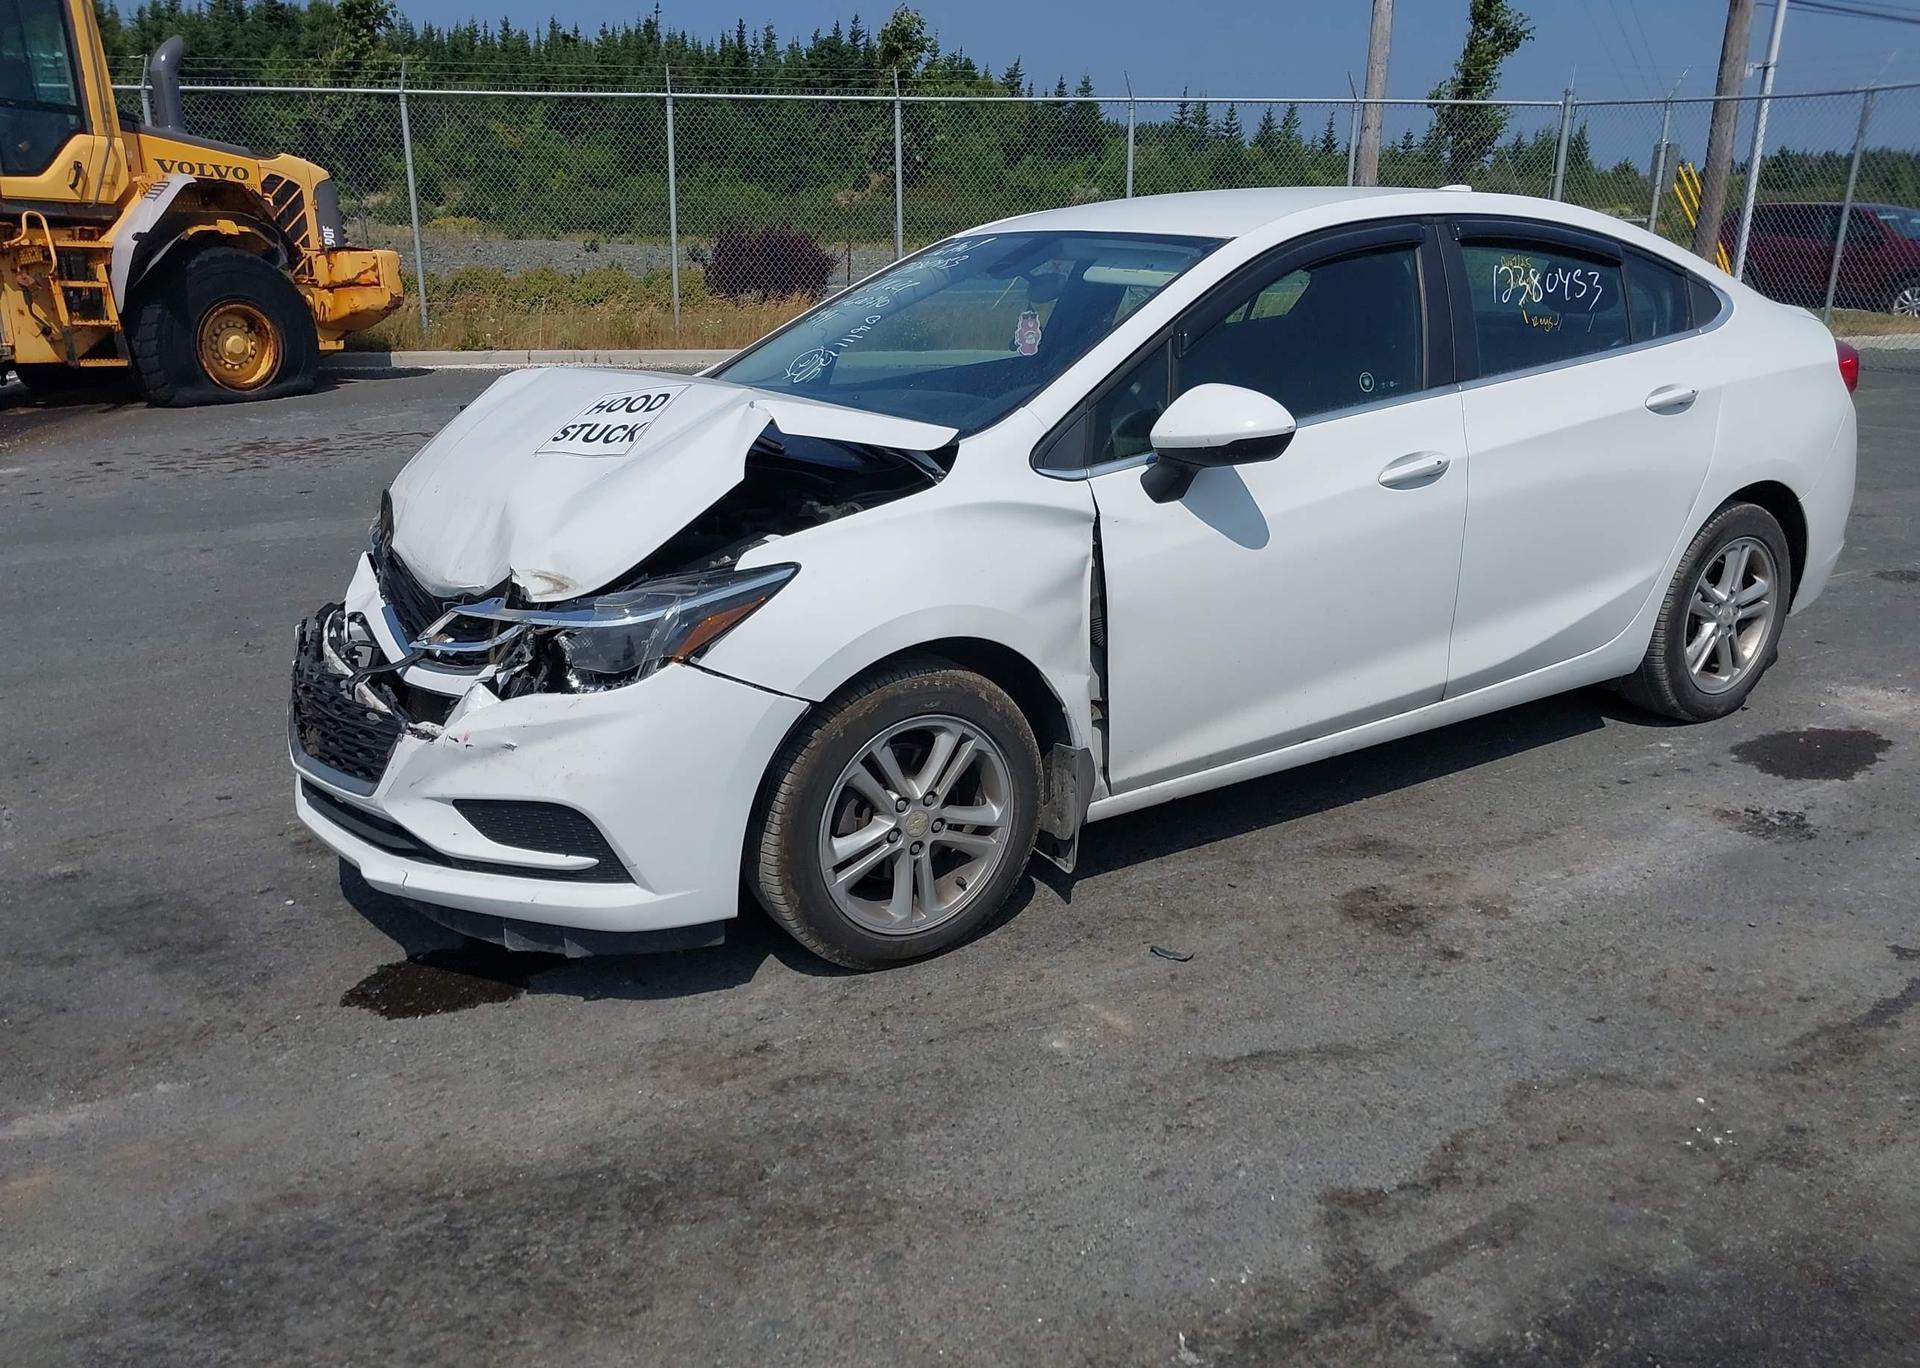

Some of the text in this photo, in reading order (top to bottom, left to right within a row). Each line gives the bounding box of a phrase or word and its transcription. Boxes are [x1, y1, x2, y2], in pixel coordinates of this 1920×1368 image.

[154, 158, 249, 181] VOLVO
[1493, 265, 1603, 311] 12380453
[585, 393, 671, 415] HOOD
[552, 422, 650, 444] STUCK
